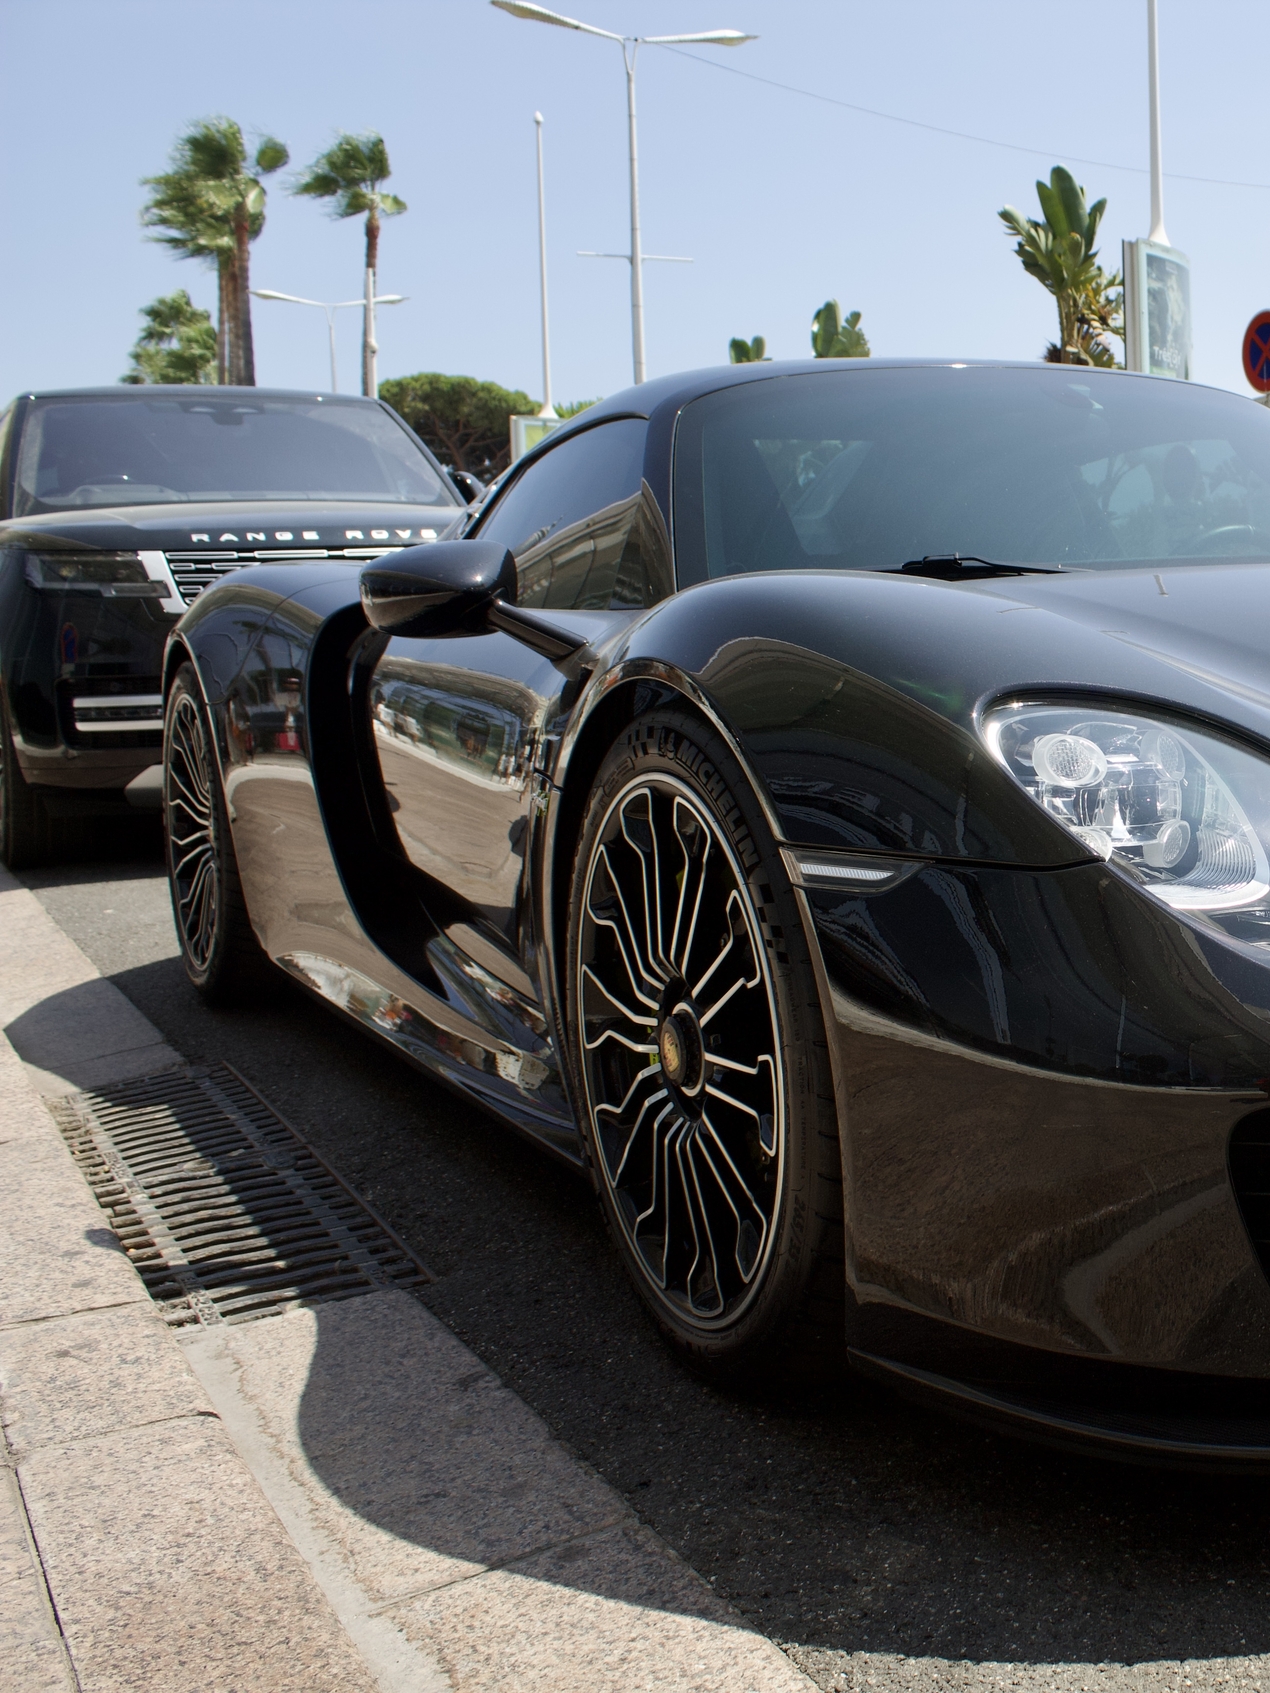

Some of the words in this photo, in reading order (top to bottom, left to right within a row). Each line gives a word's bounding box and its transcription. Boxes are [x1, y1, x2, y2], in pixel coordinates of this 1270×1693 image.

[190, 531, 320, 543] RANGE
[345, 528, 438, 541] ROVE
[676, 738, 762, 868] MICHELIN
